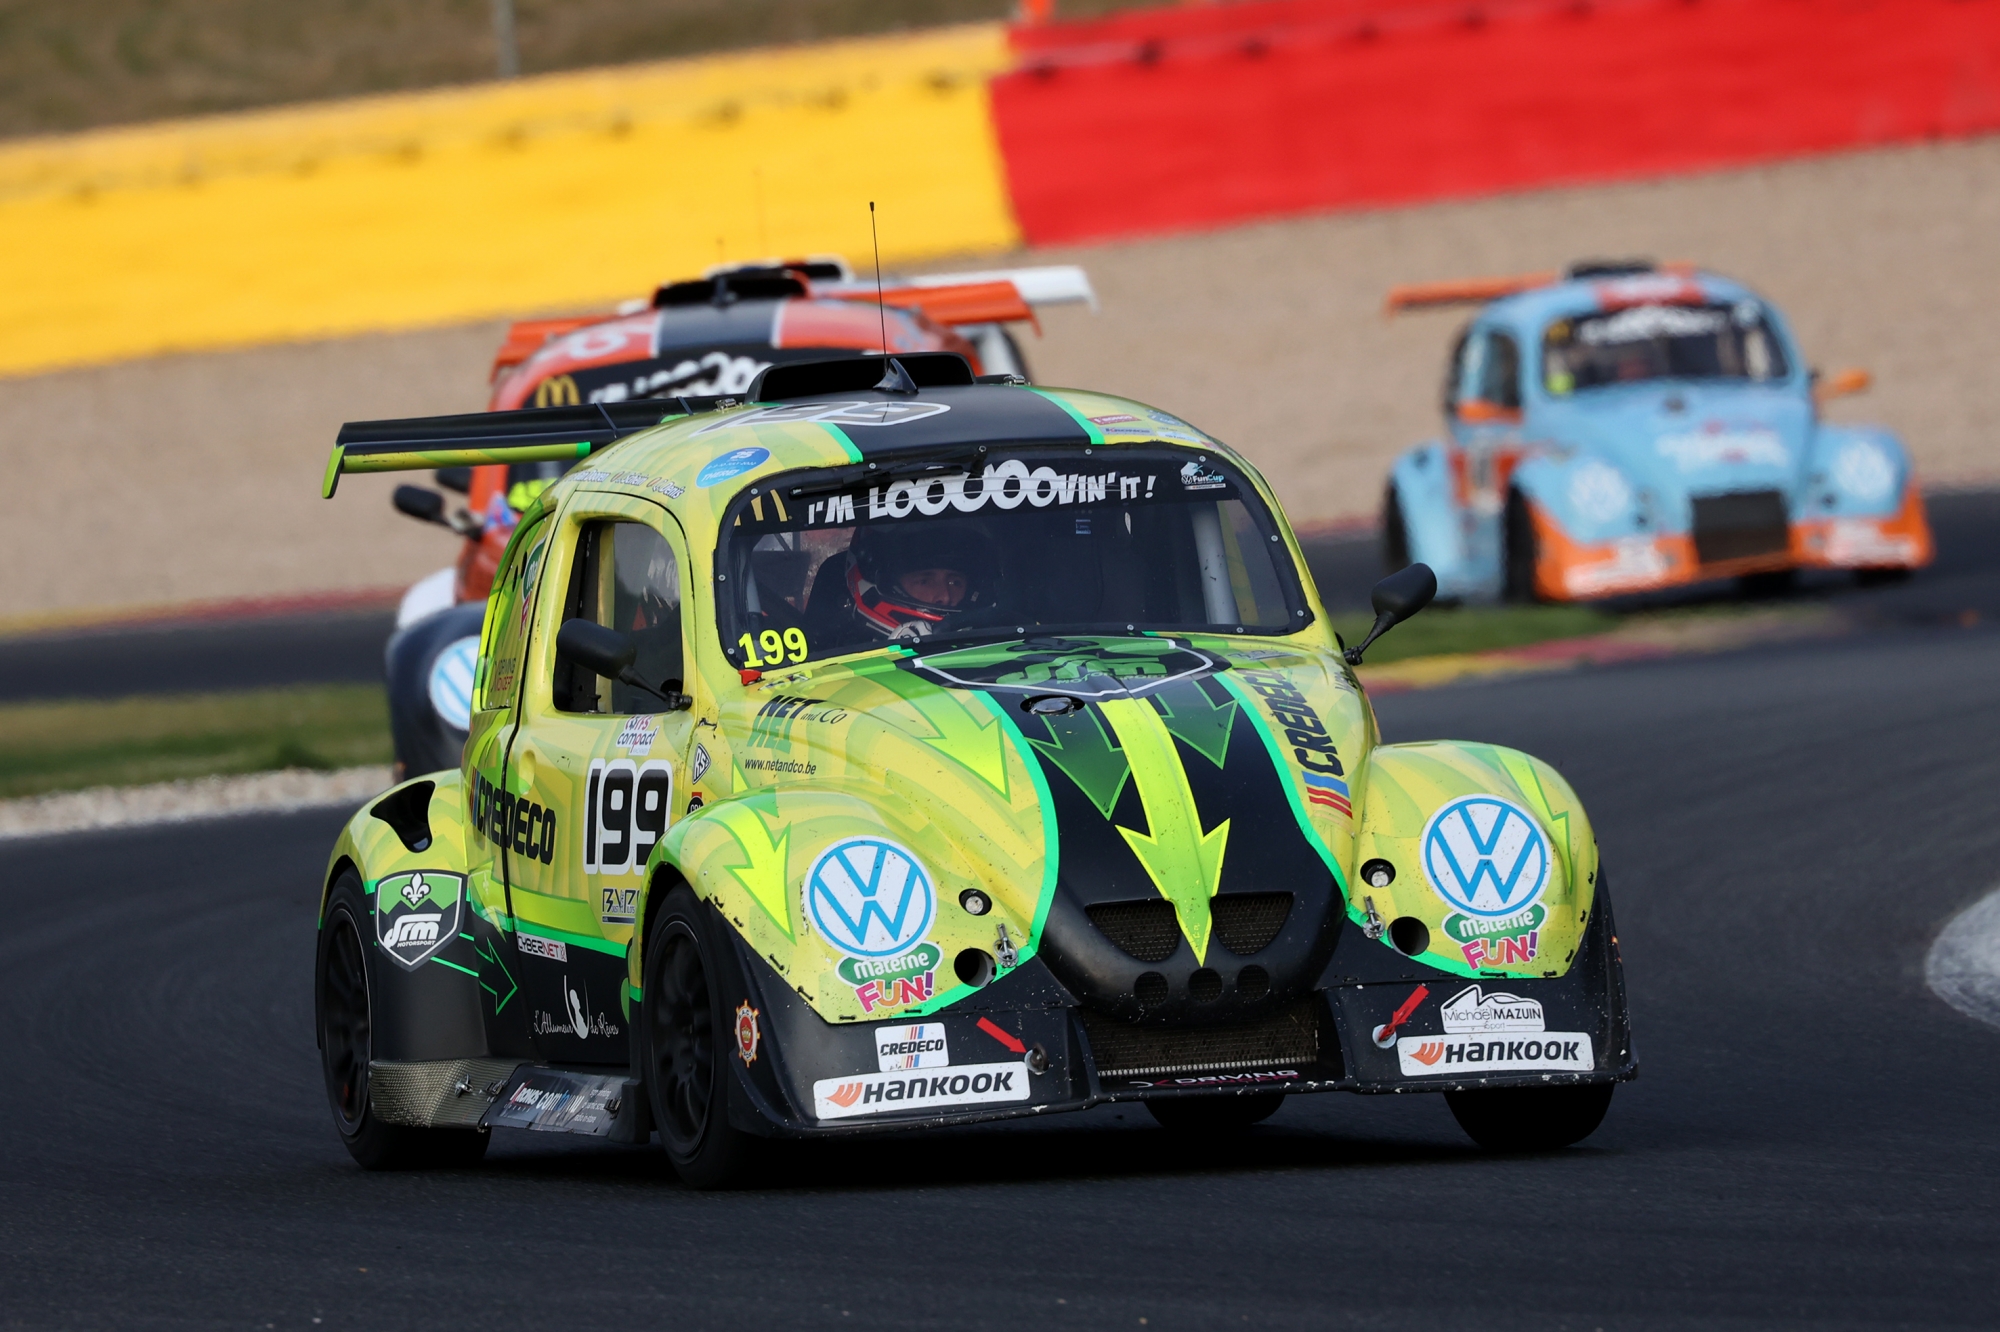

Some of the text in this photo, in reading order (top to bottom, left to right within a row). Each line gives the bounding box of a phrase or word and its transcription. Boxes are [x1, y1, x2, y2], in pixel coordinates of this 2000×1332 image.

[808, 493, 855, 525] I'M
[738, 627, 808, 669] 199
[757, 695, 828, 720] NET
[819, 708, 849, 725] Co
[1235, 669, 1345, 777] CREDECO
[744, 758, 817, 775] www.netandco.be
[477, 774, 557, 866] CREDECO
[586, 768, 670, 867] 199
[397, 940, 436, 948] MOTORSPORT
[517, 935, 560, 959] CYBERNET
[1460, 930, 1539, 971] FUN!
[855, 970, 935, 1014] FUN!
[1493, 1007, 1541, 1020] MAZUIN
[880, 1038, 945, 1057] CREDECO
[1174, 1069, 1299, 1085] DRIVING
